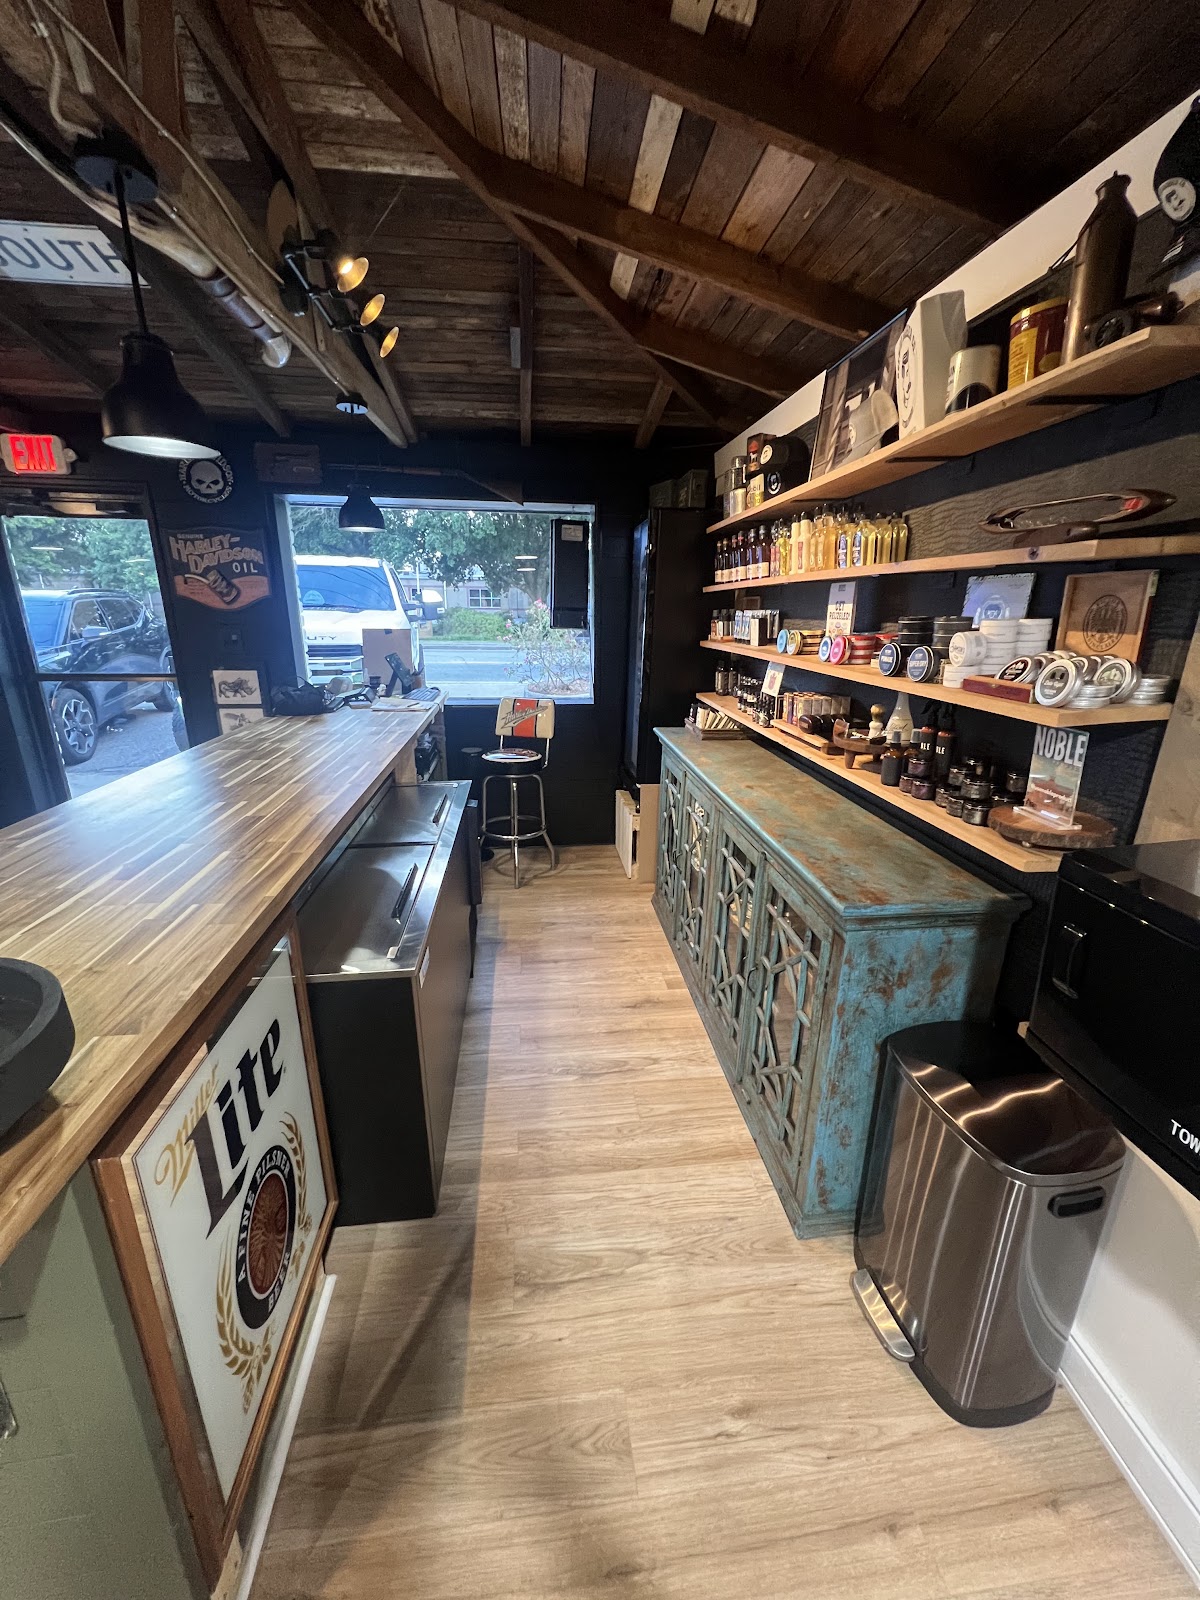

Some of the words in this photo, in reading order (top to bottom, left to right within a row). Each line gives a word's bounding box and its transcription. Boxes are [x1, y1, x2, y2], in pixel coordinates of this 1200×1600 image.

[0, 235, 125, 273] OUTH
[9, 436, 57, 471] EXIT
[187, 547, 264, 574] DAVIDSON
[232, 562, 258, 573] OIL
[1033, 725, 1087, 768] NOBLE
[154, 1060, 220, 1208] Miller
[185, 1018, 284, 1240] Lite
[1170, 1118, 1200, 1156] TOW
[238, 1190, 256, 1259] FINE
[255, 1149, 291, 1185] PILSNER
[268, 1251, 292, 1313] BEER
